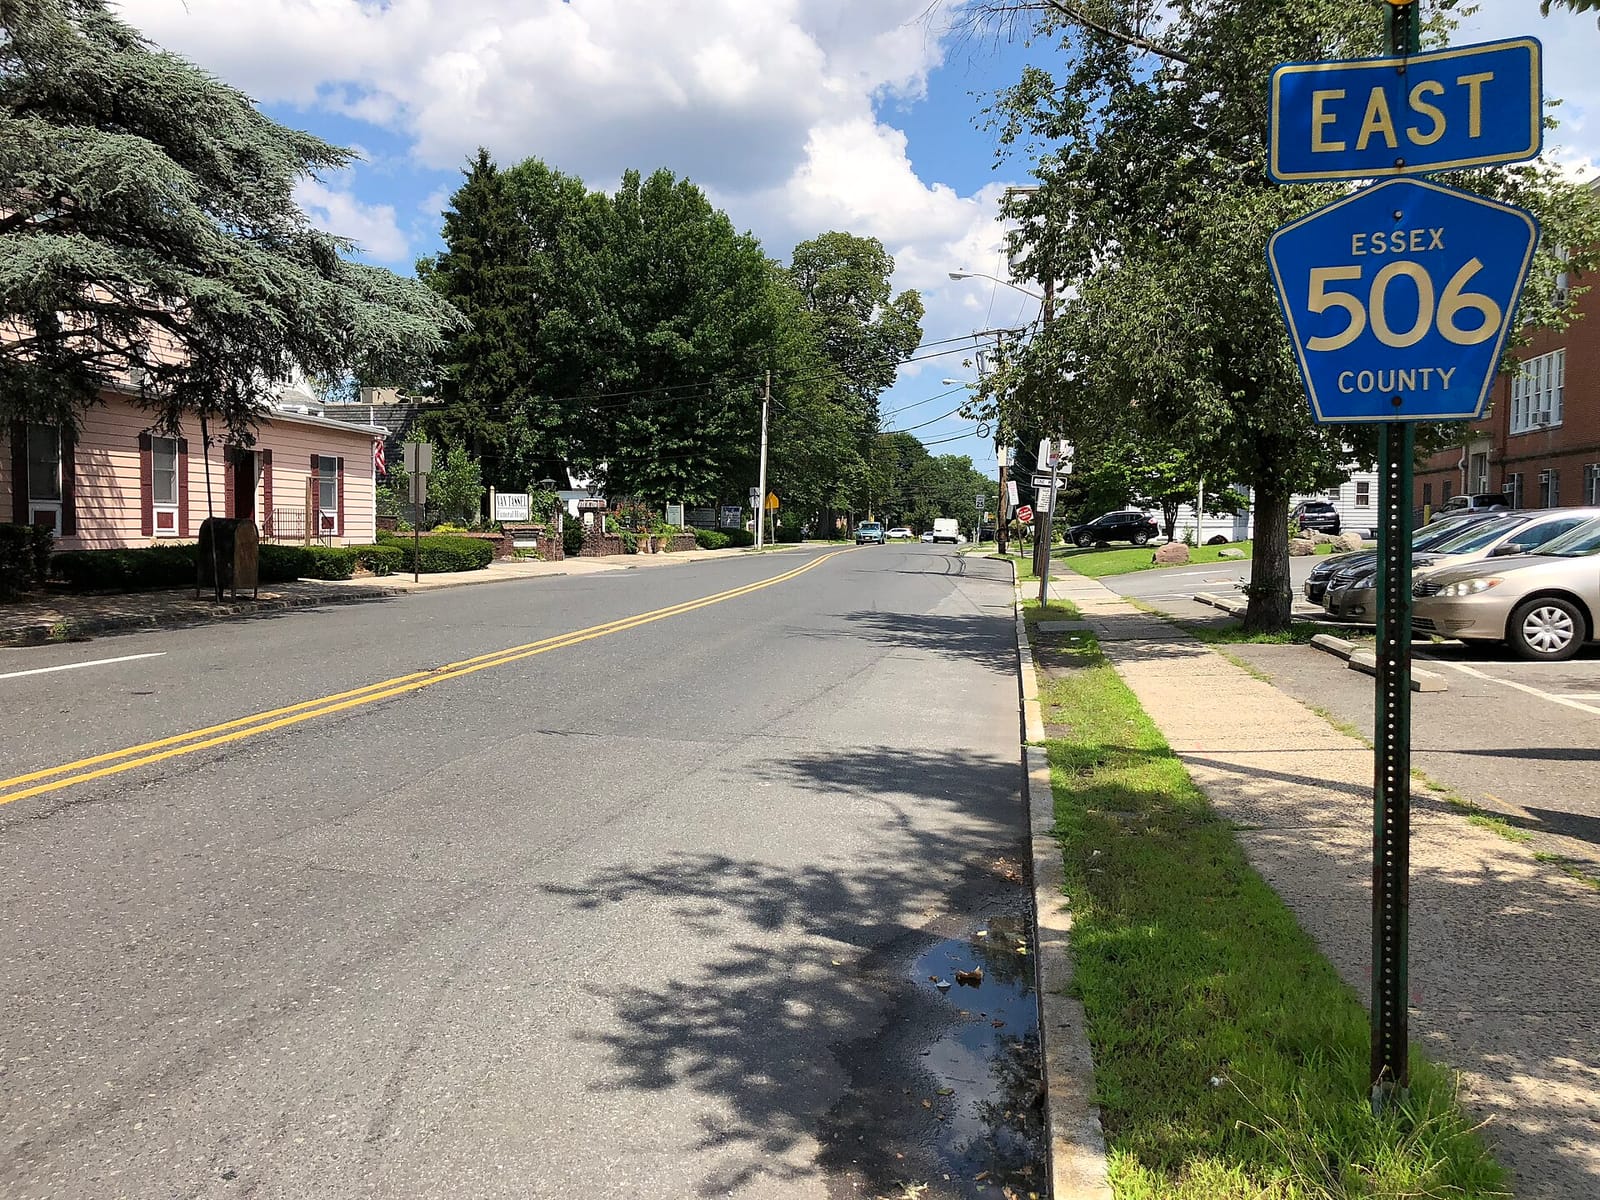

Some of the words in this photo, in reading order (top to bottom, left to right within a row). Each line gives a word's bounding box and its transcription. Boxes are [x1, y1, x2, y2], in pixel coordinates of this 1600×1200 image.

[1311, 71, 1494, 153] EAST
[1351, 227, 1444, 256] ESSEX
[1306, 257, 1501, 351] 506
[1337, 366, 1456, 394] COUNTY
[497, 495, 507, 507] VAN
[508, 495, 527, 507] TASSEL
